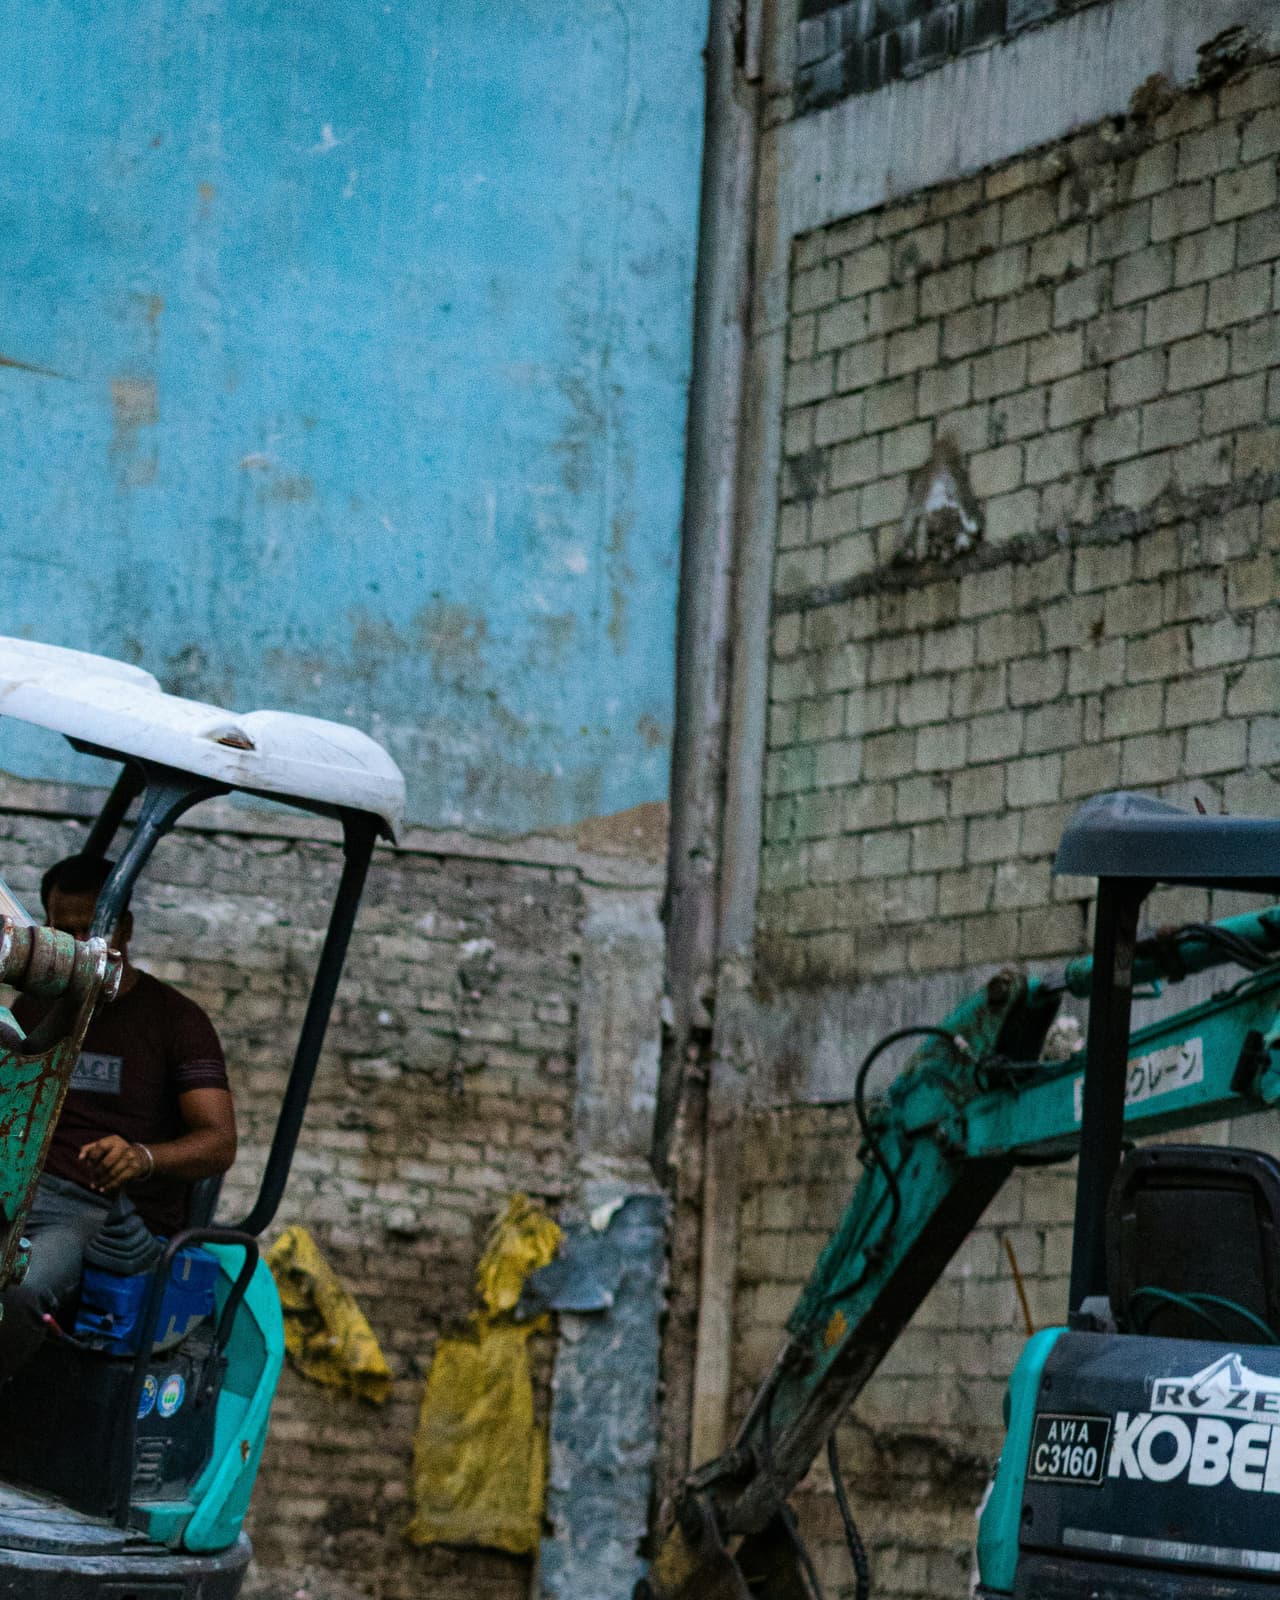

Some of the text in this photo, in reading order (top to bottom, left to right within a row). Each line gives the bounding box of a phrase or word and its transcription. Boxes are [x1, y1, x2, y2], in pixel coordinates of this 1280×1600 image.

[1124, 1050, 1197, 1097] クレーン
[1034, 1443, 1098, 1478] C3160
